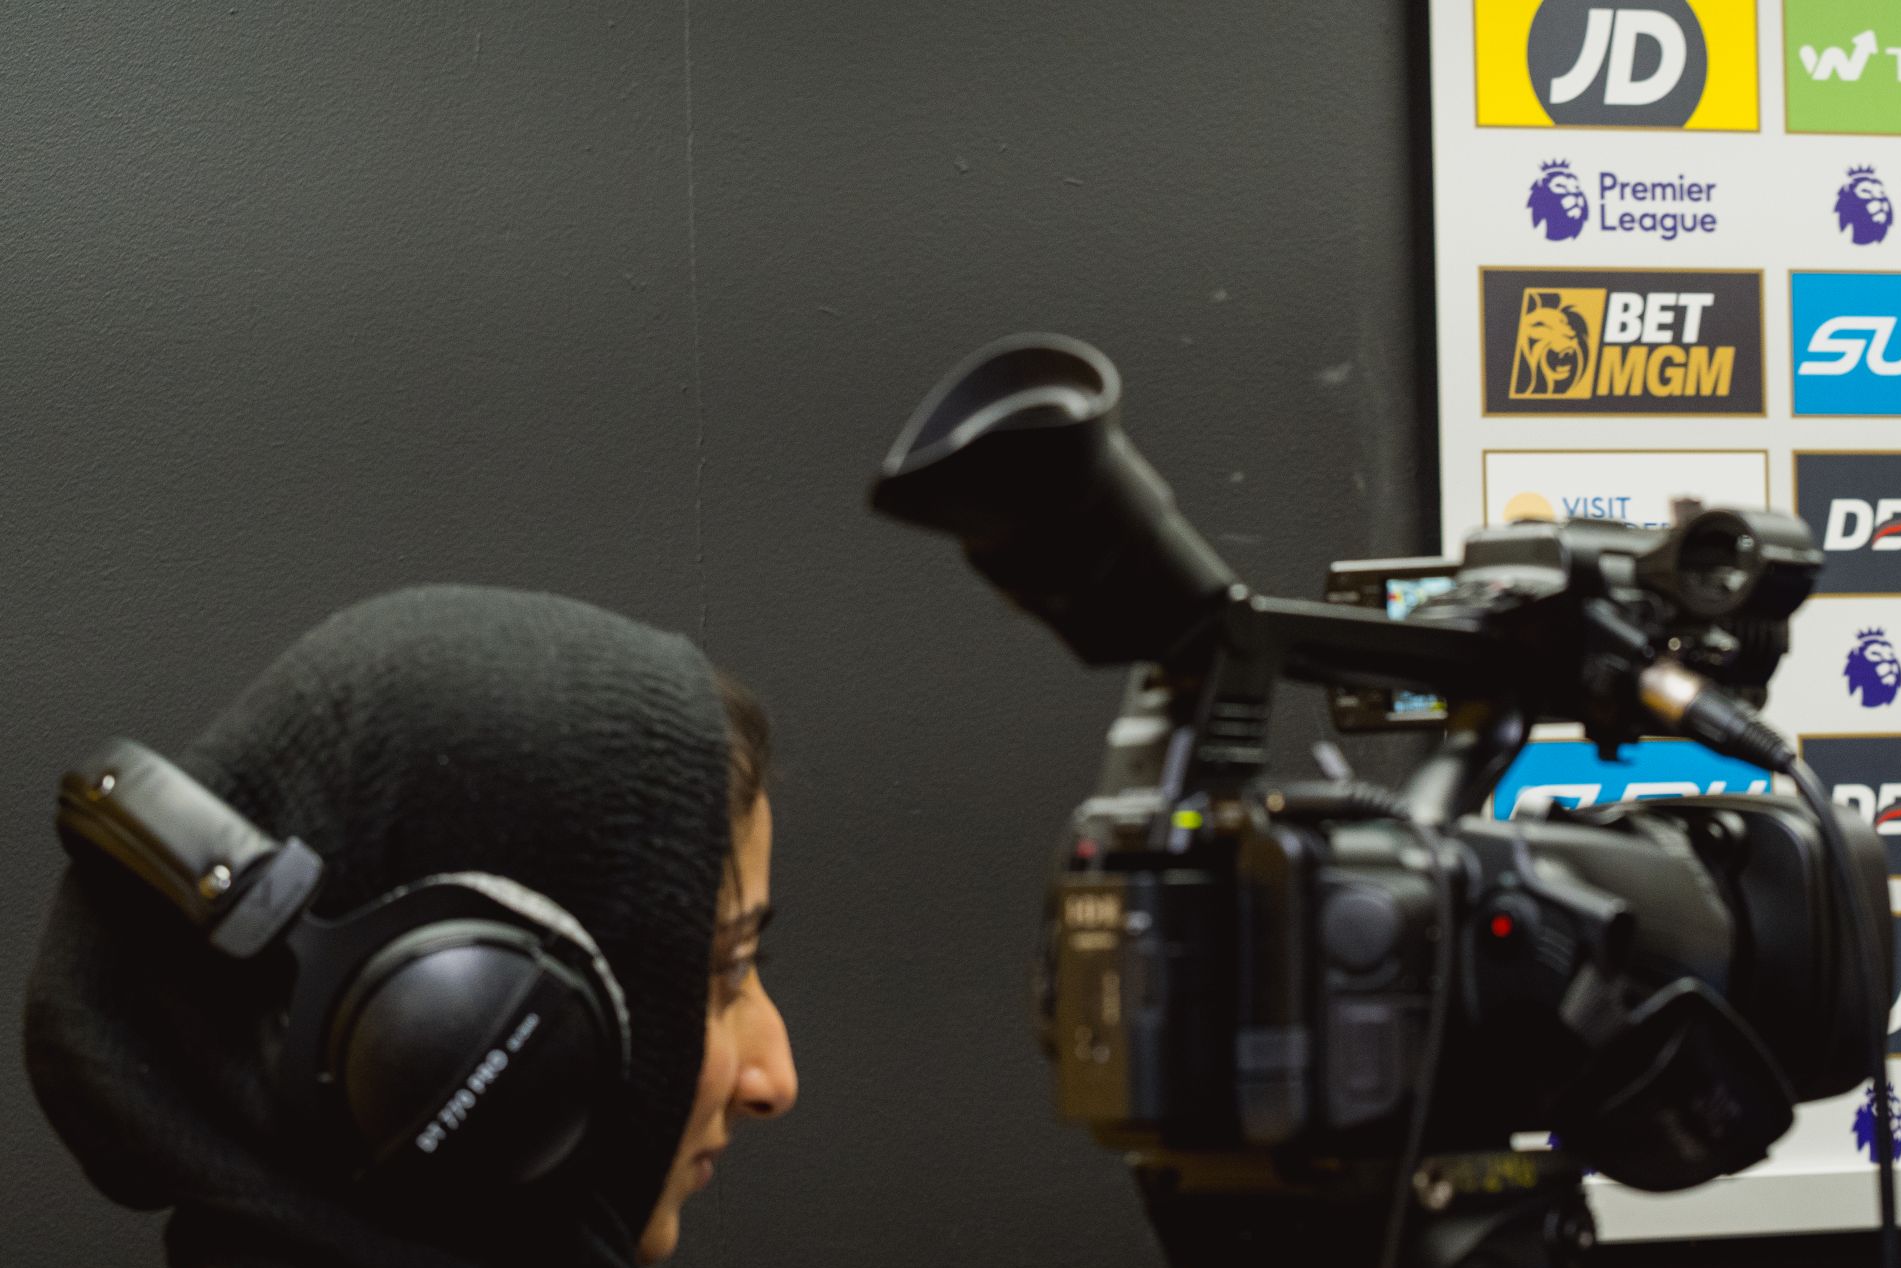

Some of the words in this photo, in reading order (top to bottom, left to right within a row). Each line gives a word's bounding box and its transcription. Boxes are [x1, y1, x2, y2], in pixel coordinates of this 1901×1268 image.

[1549, 8, 1686, 104] JD
[1599, 172, 1716, 202] Premier
[1599, 203, 1717, 240] League
[1605, 292, 1714, 344] BET
[1596, 345, 1735, 397] MGM
[1562, 496, 1631, 520] VISIT
